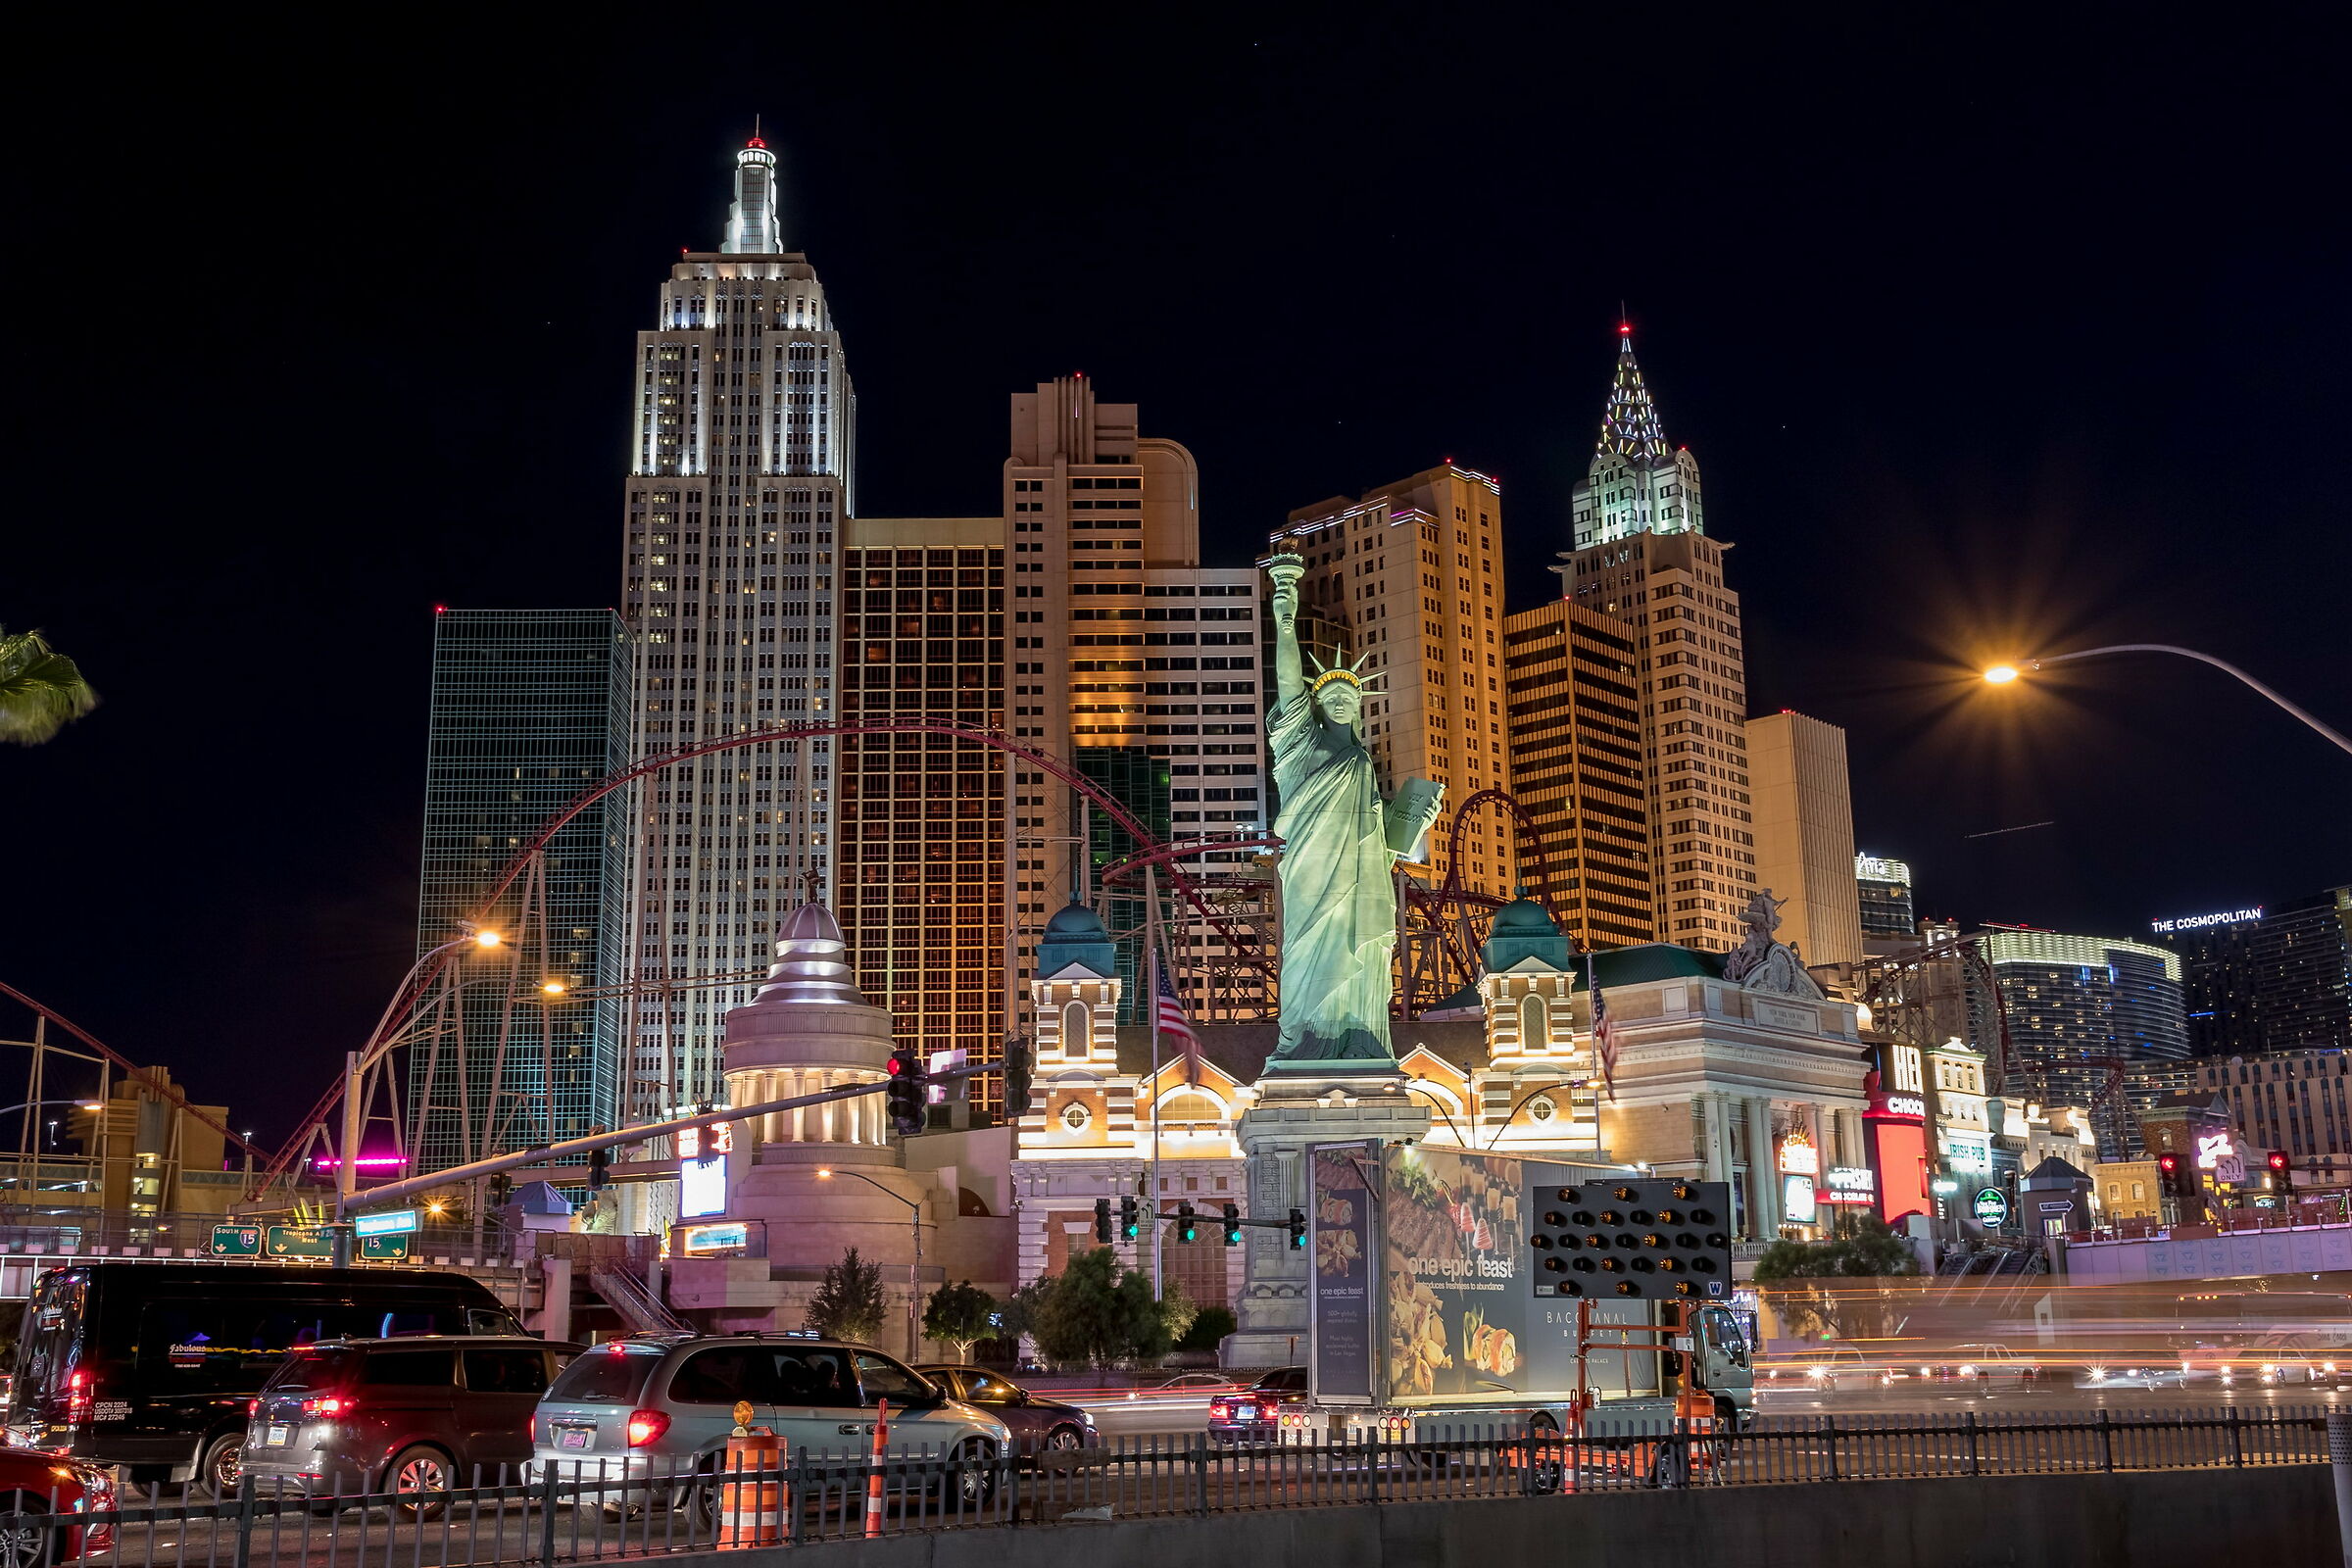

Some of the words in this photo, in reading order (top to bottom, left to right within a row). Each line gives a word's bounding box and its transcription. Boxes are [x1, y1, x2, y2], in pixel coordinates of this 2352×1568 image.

[2152, 920, 2175, 932] THE
[2177, 907, 2261, 930] COSMOPOLITAN
[1949, 1144, 1970, 1159] IRISH
[1971, 1146, 1985, 1161] PUB
[243, 1234, 255, 1245] 15
[368, 1238, 380, 1248] 15
[1408, 1256, 1439, 1276] one
[1442, 1253, 1474, 1282] epic
[1476, 1254, 1513, 1278] feast
[1334, 1287, 1348, 1296] epic
[1476, 1282, 1505, 1291] abundance
[1709, 1282, 1722, 1296] W
[1563, 1329, 1613, 1338] BUFET
[169, 1344, 206, 1353] Fabulous
